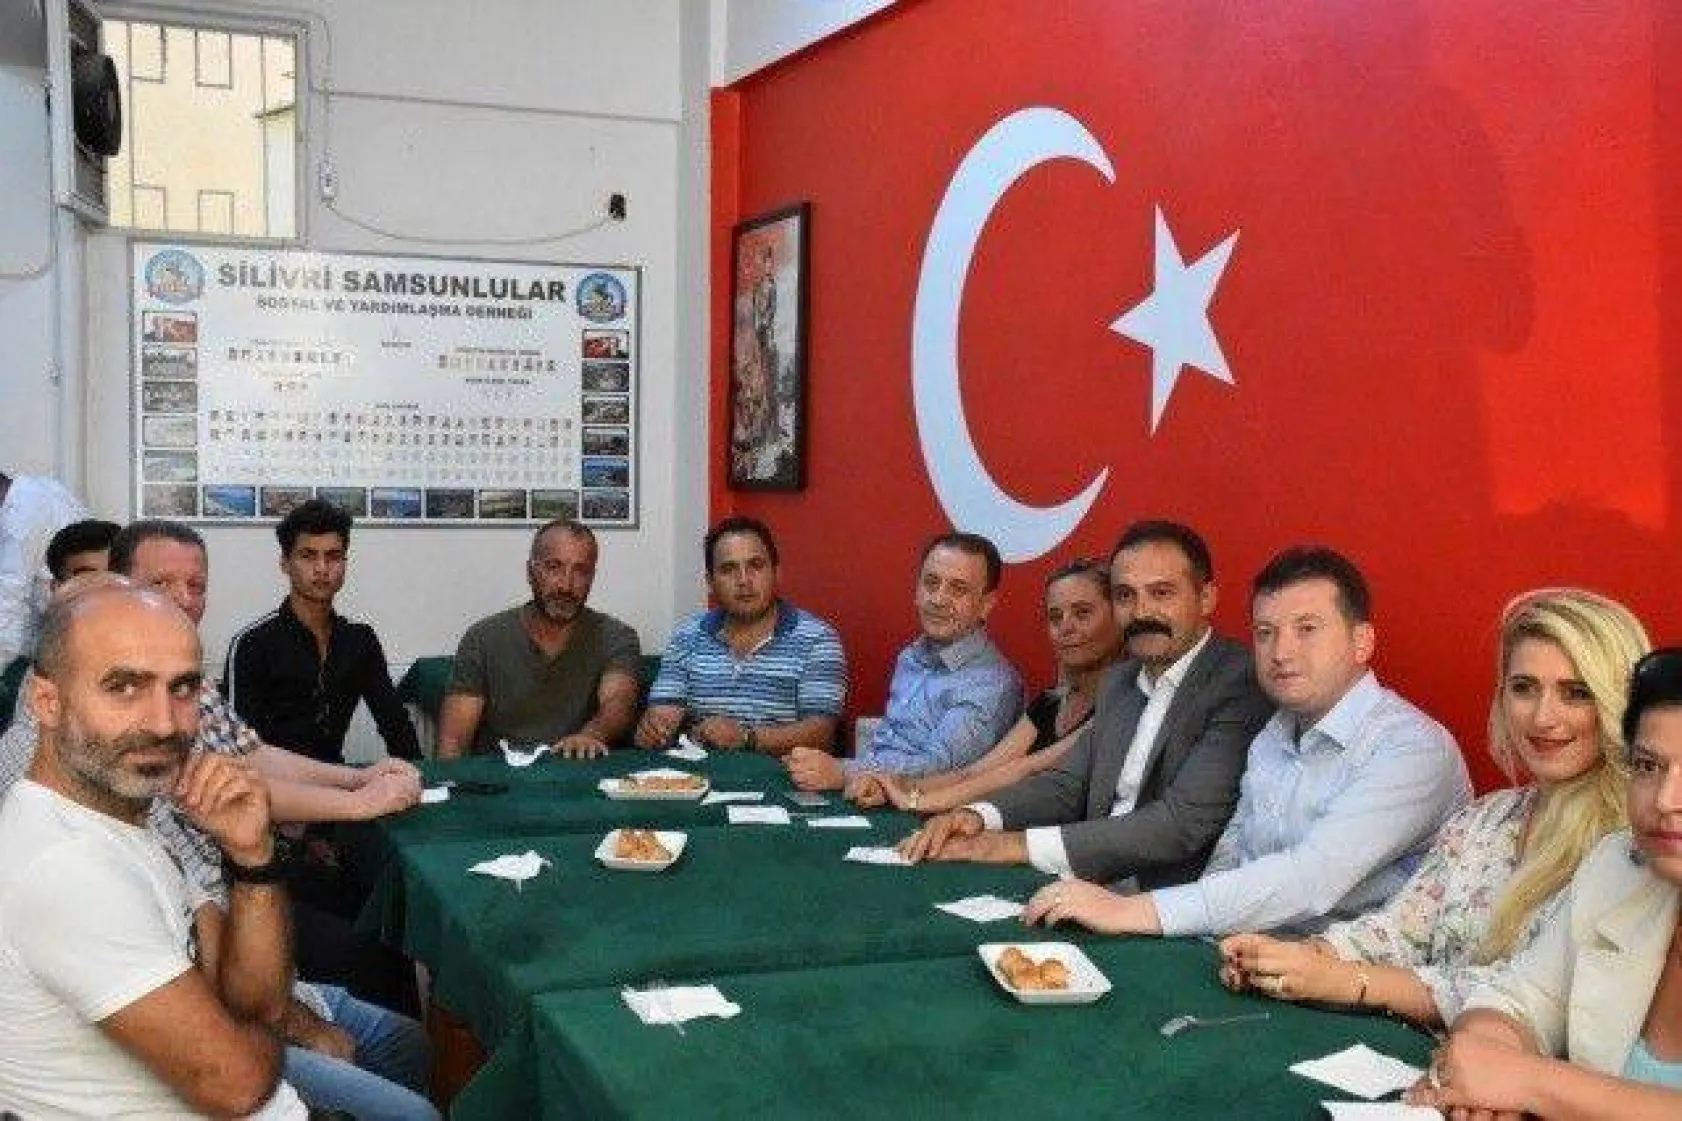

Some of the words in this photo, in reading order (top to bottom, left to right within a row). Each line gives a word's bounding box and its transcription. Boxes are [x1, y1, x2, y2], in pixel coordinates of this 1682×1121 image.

[217, 260, 333, 291] SİLİVRİ
[342, 270, 567, 302] SAMSUNLULAR
[324, 297, 345, 312] VE
[349, 299, 462, 317] YARDIMLAŞMA
